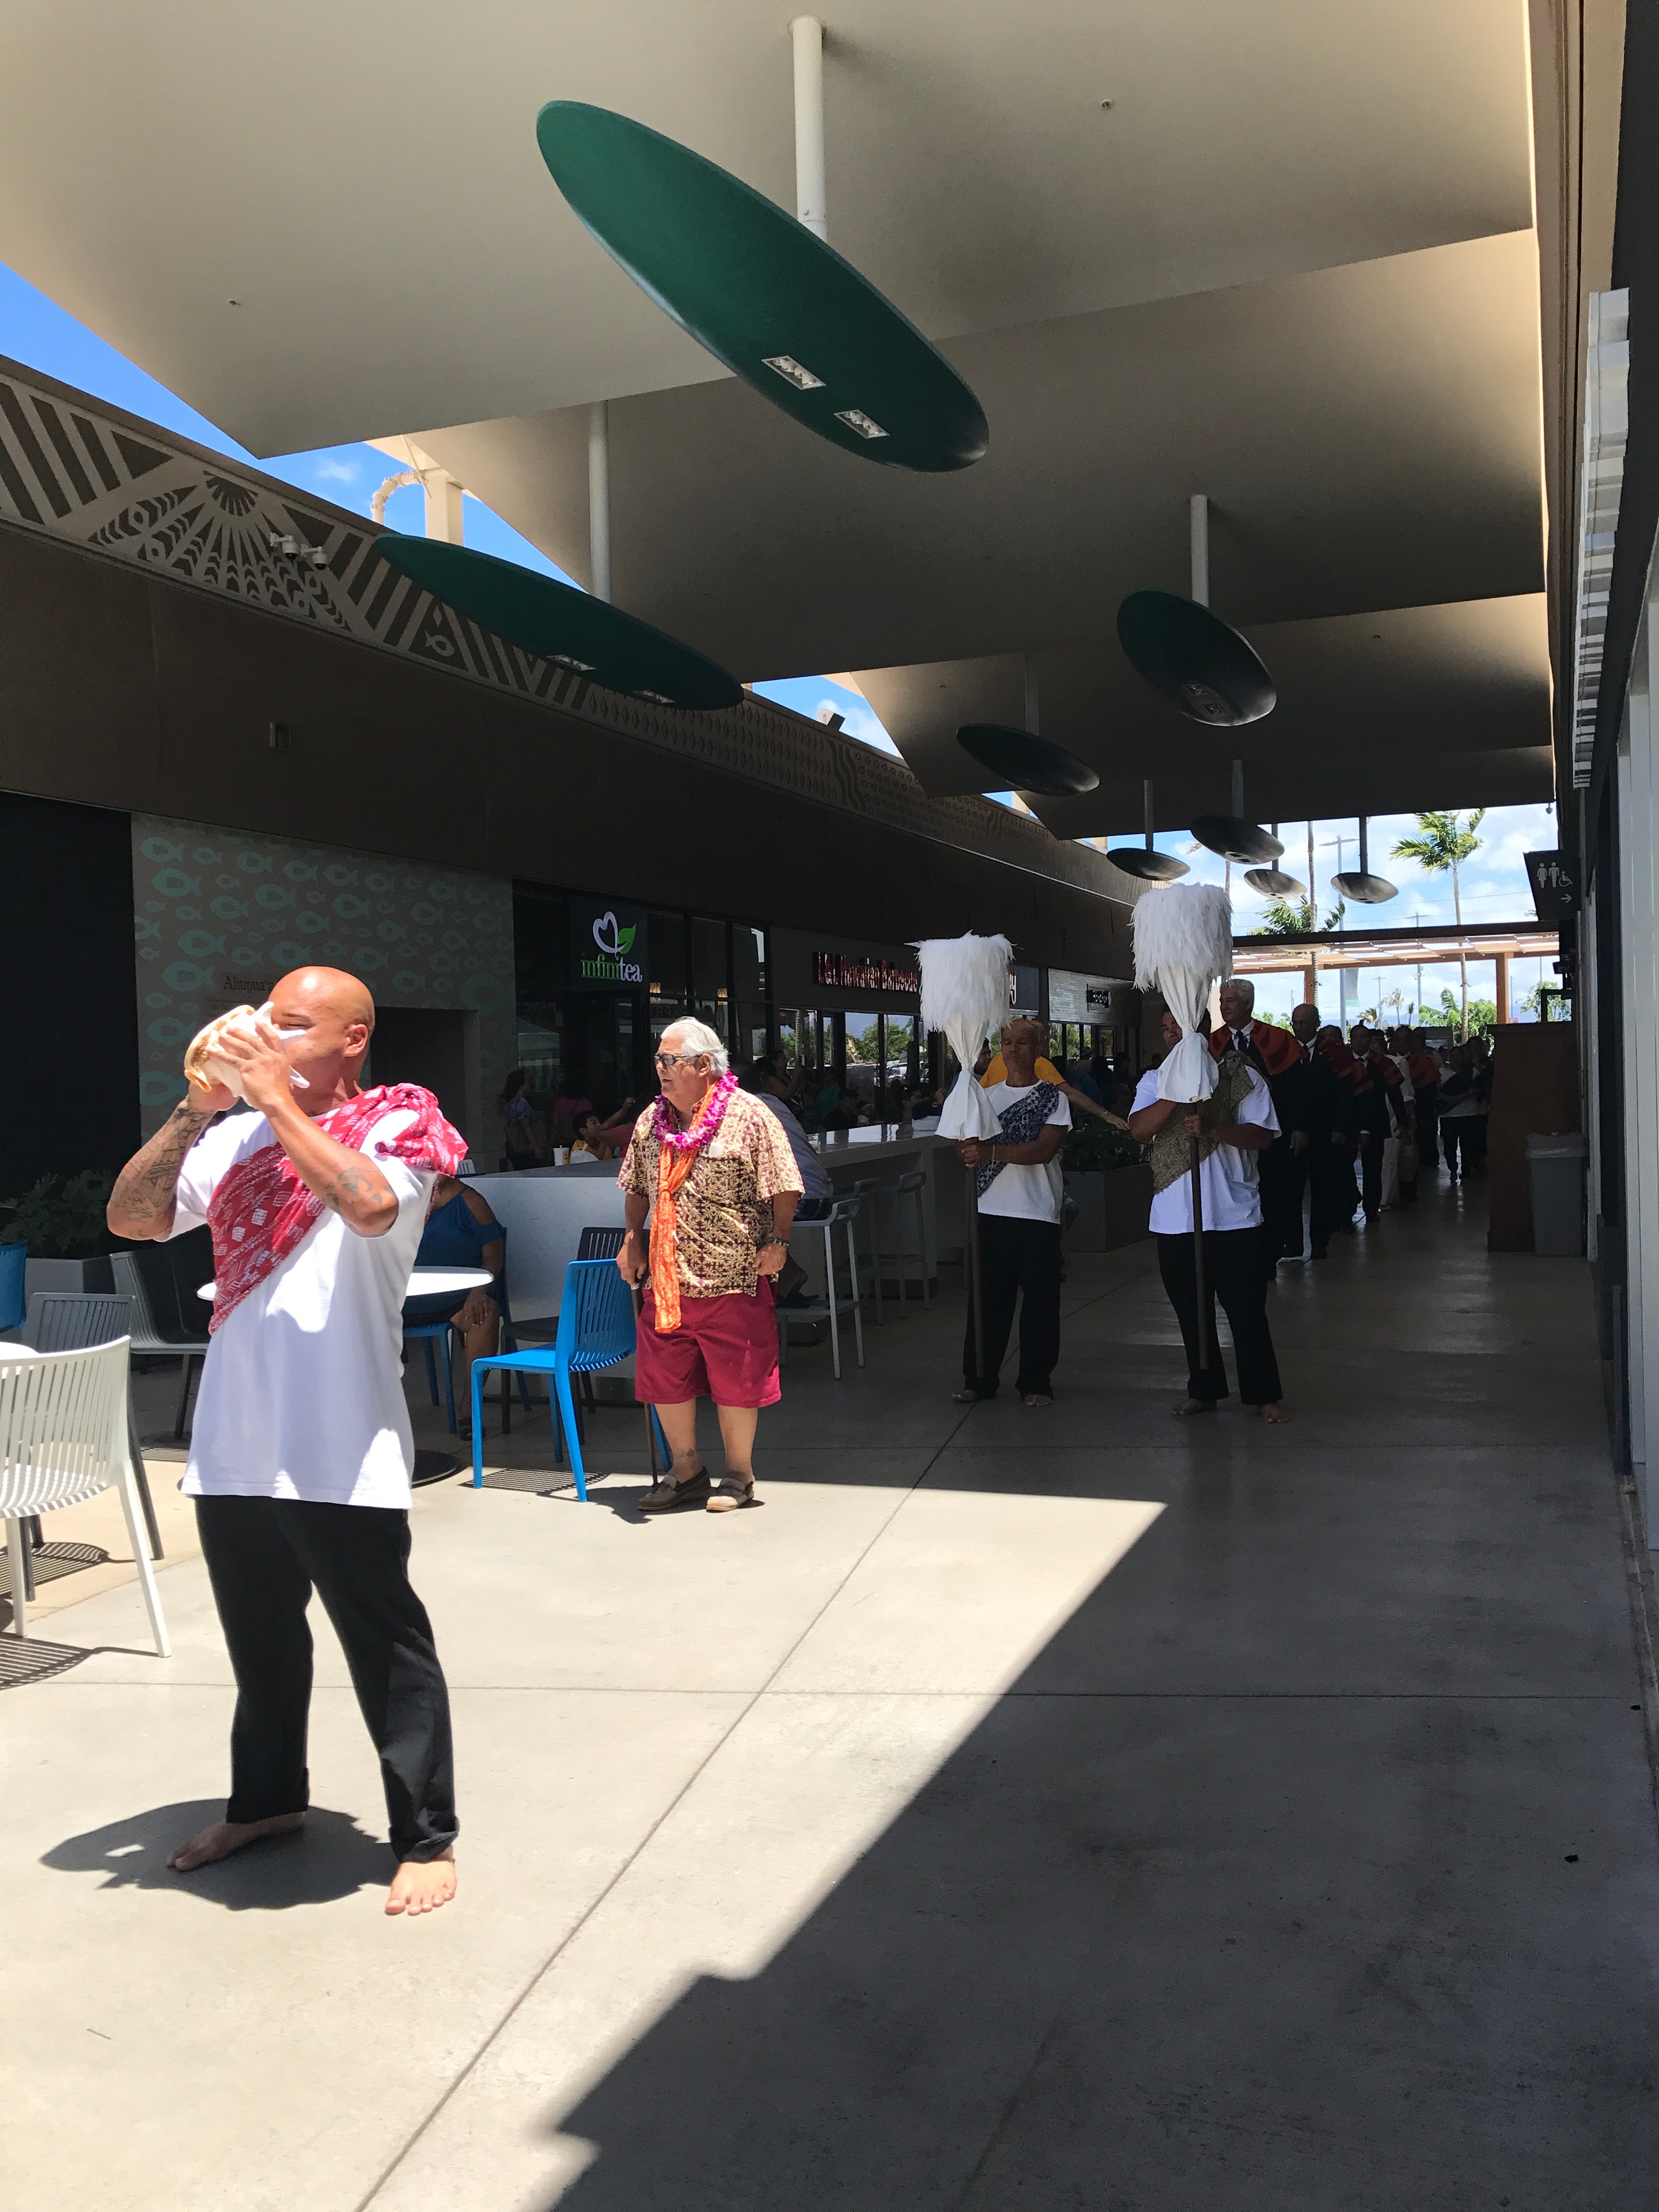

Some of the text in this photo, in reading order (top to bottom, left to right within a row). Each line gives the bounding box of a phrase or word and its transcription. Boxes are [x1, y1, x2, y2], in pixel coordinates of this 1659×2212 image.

[580, 952, 643, 983] infinitea
[840, 955, 881, 988] Hawaiian
[882, 960, 918, 993] Barbecue
